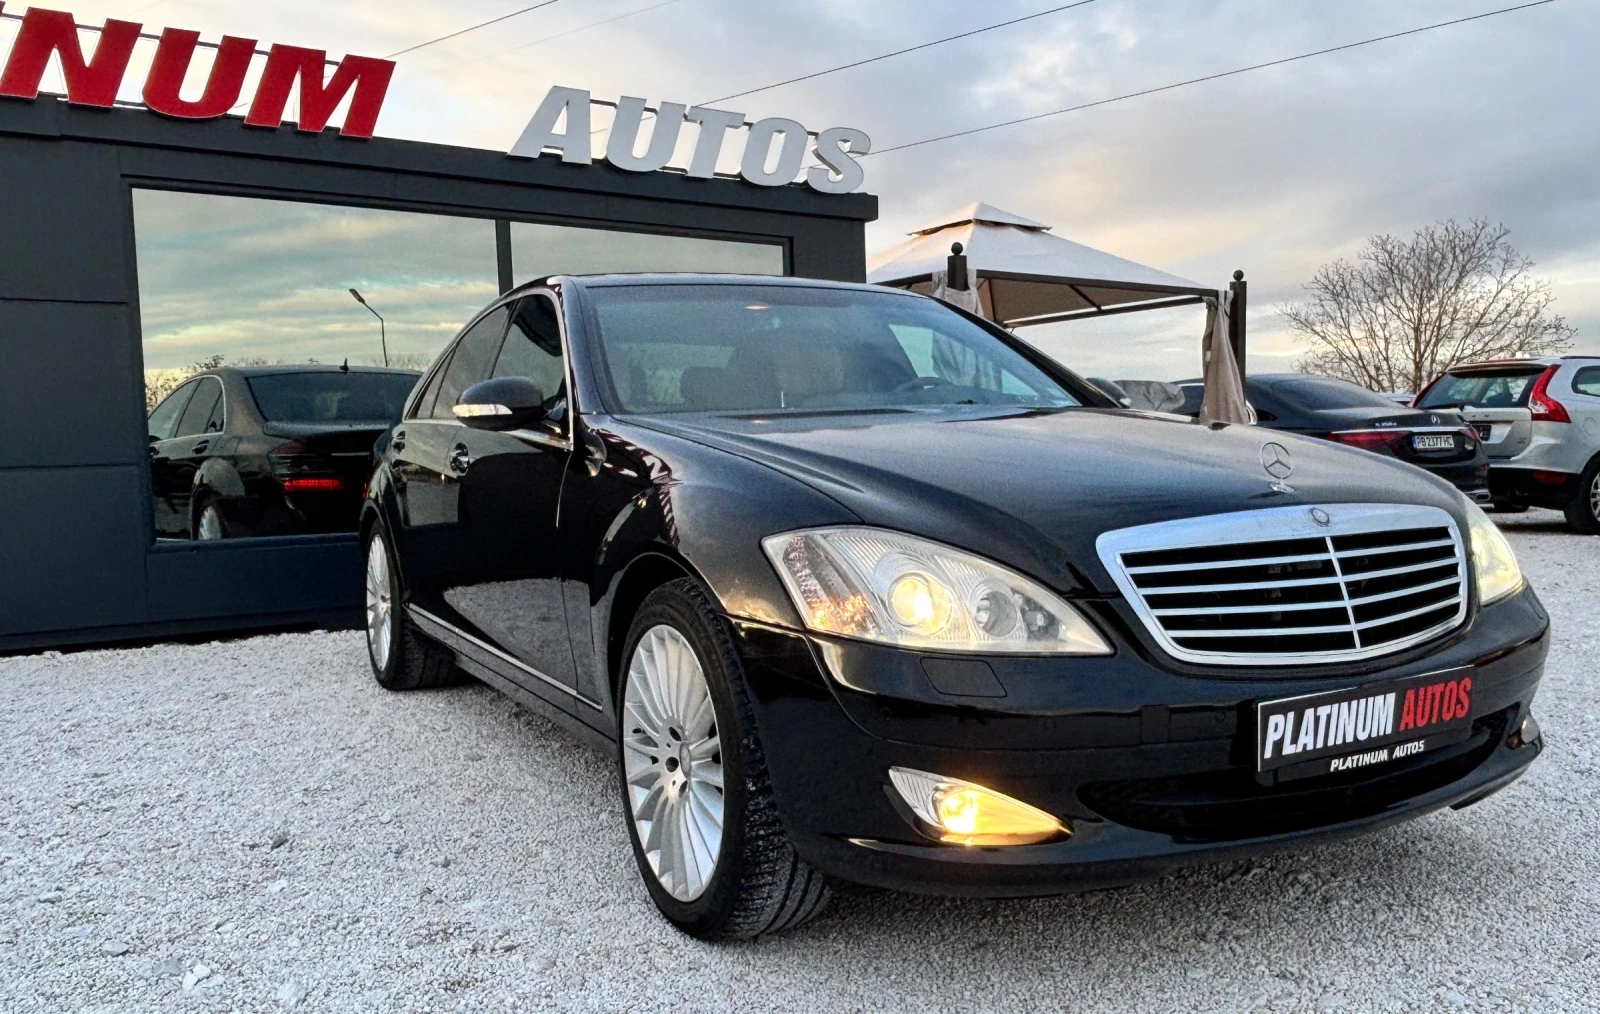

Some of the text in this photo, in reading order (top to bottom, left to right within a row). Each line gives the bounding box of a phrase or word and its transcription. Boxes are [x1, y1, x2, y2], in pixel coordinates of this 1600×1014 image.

[0, 1, 871, 194] NUM AUTOS
[1426, 436, 1442, 447] 2377
[1264, 677, 1472, 759] PLATINUM AUTOS
[1330, 740, 1425, 772] PLATINUM AUTOS
